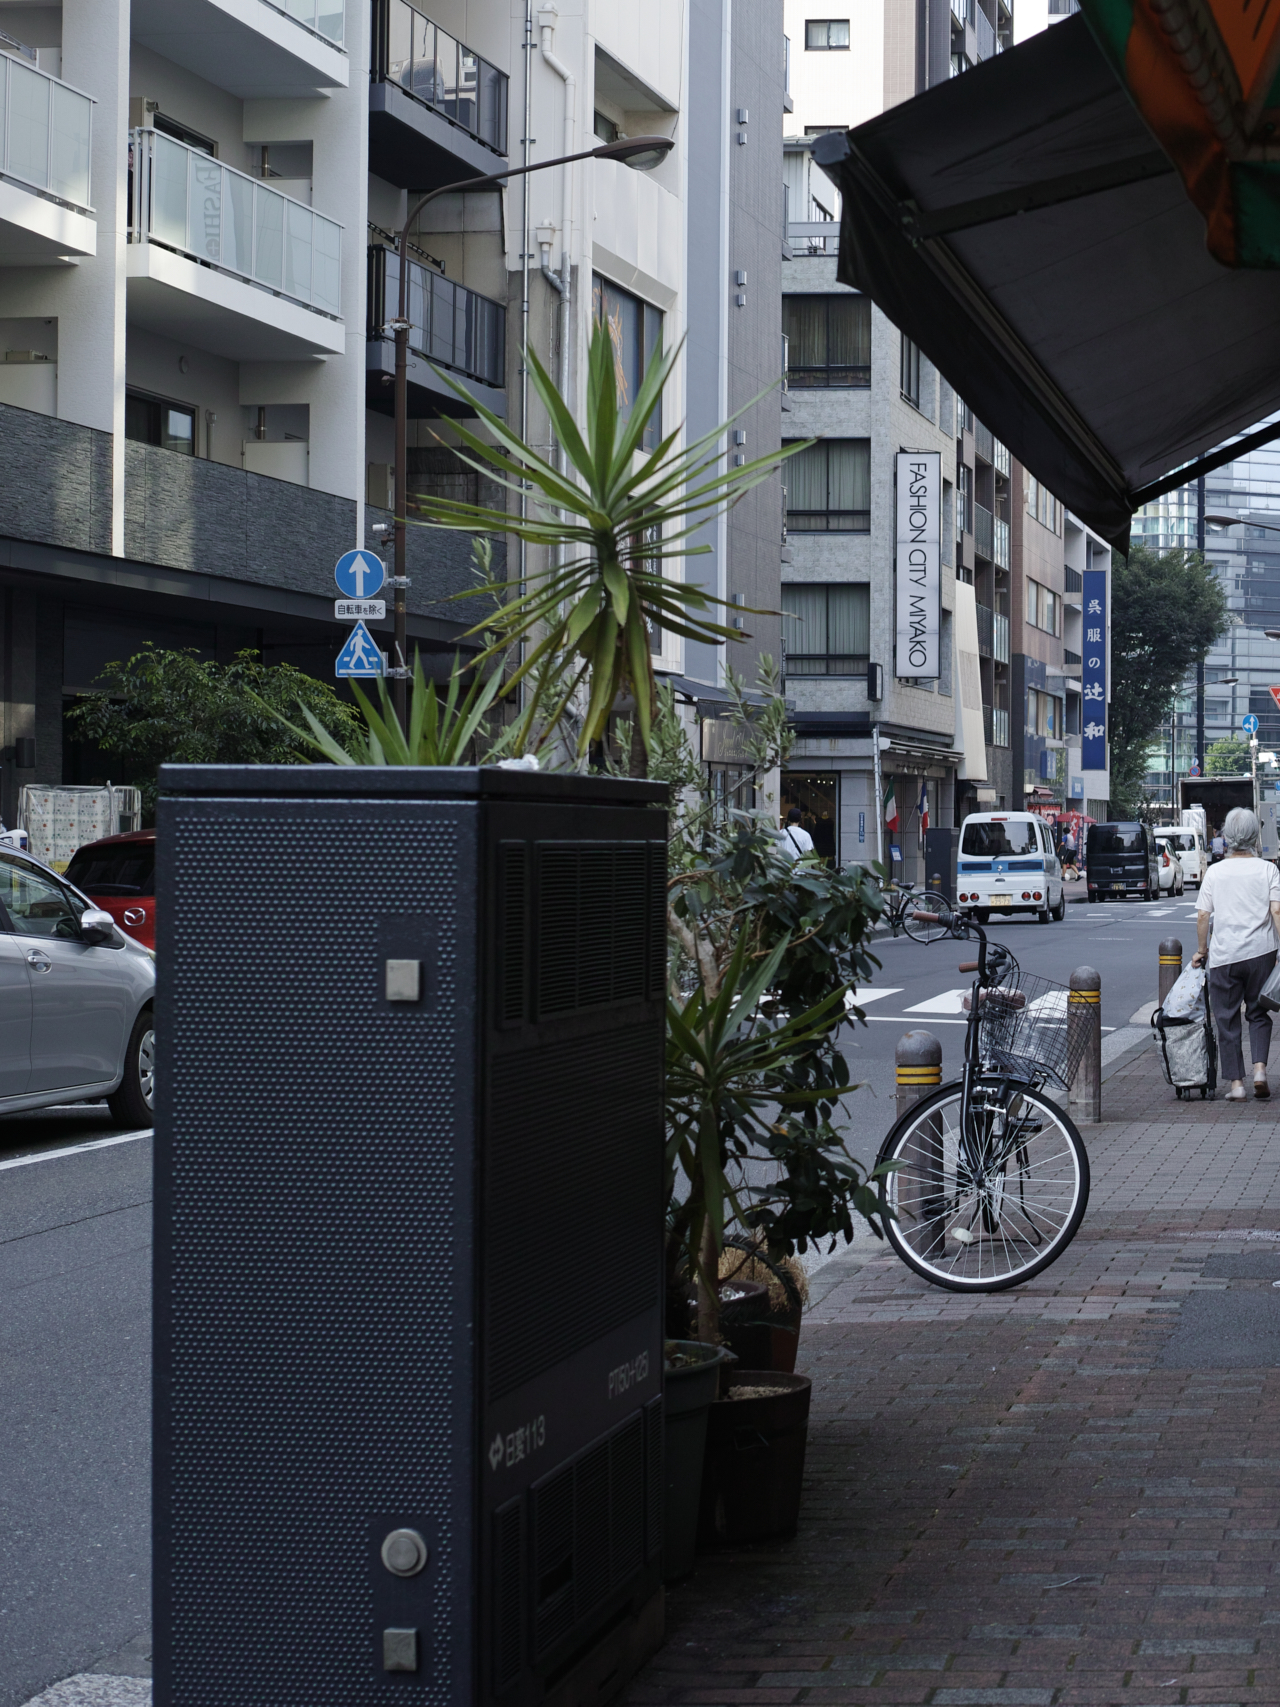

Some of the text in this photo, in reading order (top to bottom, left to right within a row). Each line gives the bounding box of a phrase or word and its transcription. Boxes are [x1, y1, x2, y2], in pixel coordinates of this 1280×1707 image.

[337, 603, 383, 616] 自転車を除く
[909, 462, 927, 668] FASHION CITY MIYAKO
[1083, 599, 1105, 741] 呉服の辻和
